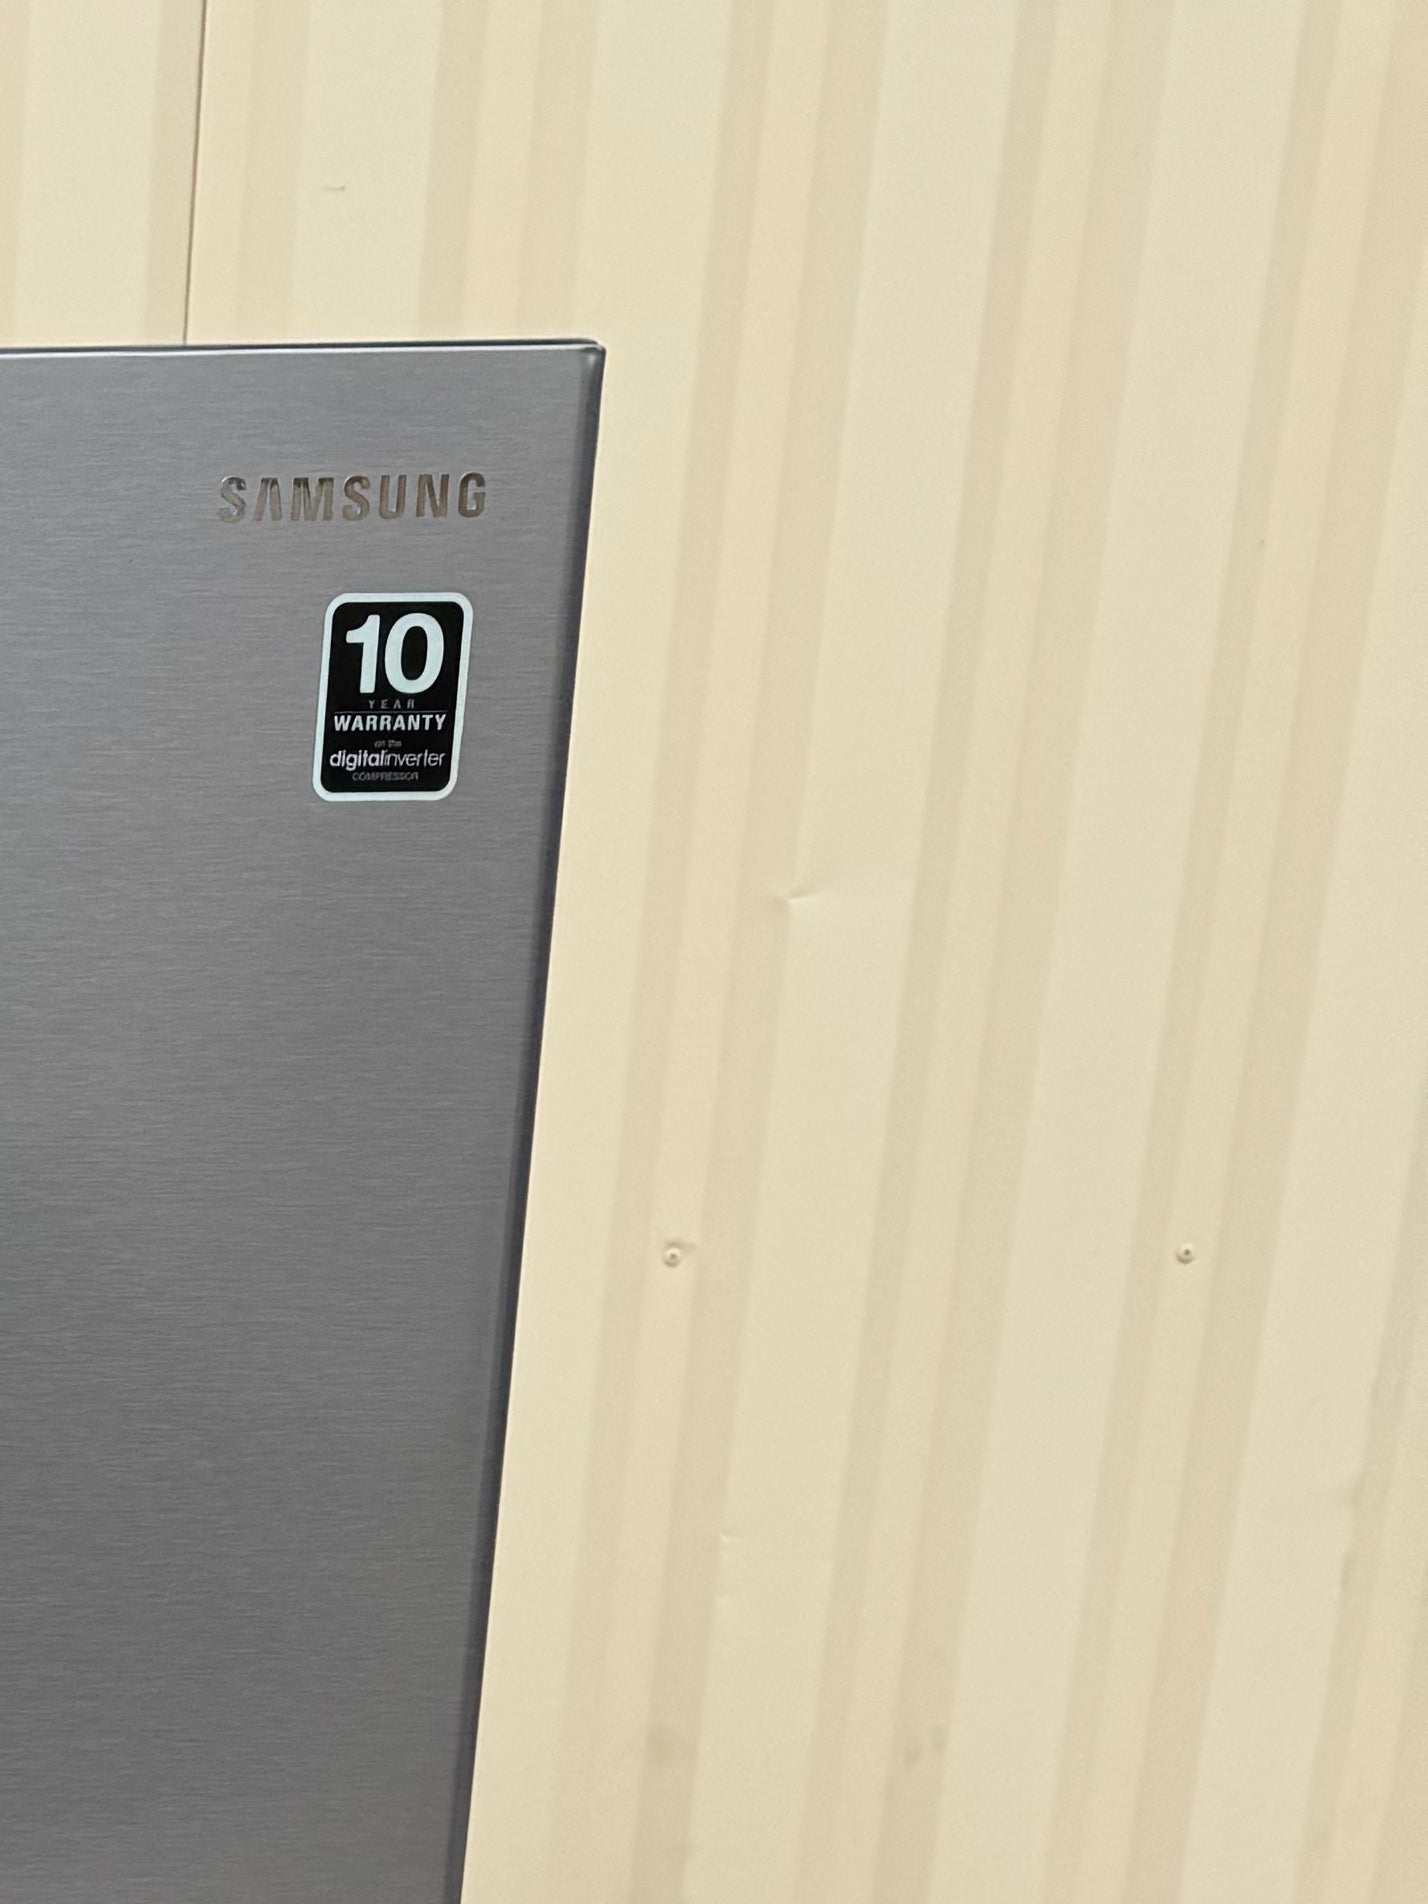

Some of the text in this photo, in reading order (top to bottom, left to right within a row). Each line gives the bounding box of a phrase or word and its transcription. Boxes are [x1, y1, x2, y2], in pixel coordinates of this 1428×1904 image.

[218, 472, 486, 523] SAMSUNG
[344, 611, 446, 695] 10
[332, 712, 448, 733] WARRANTY
[367, 698, 417, 711] YEAR
